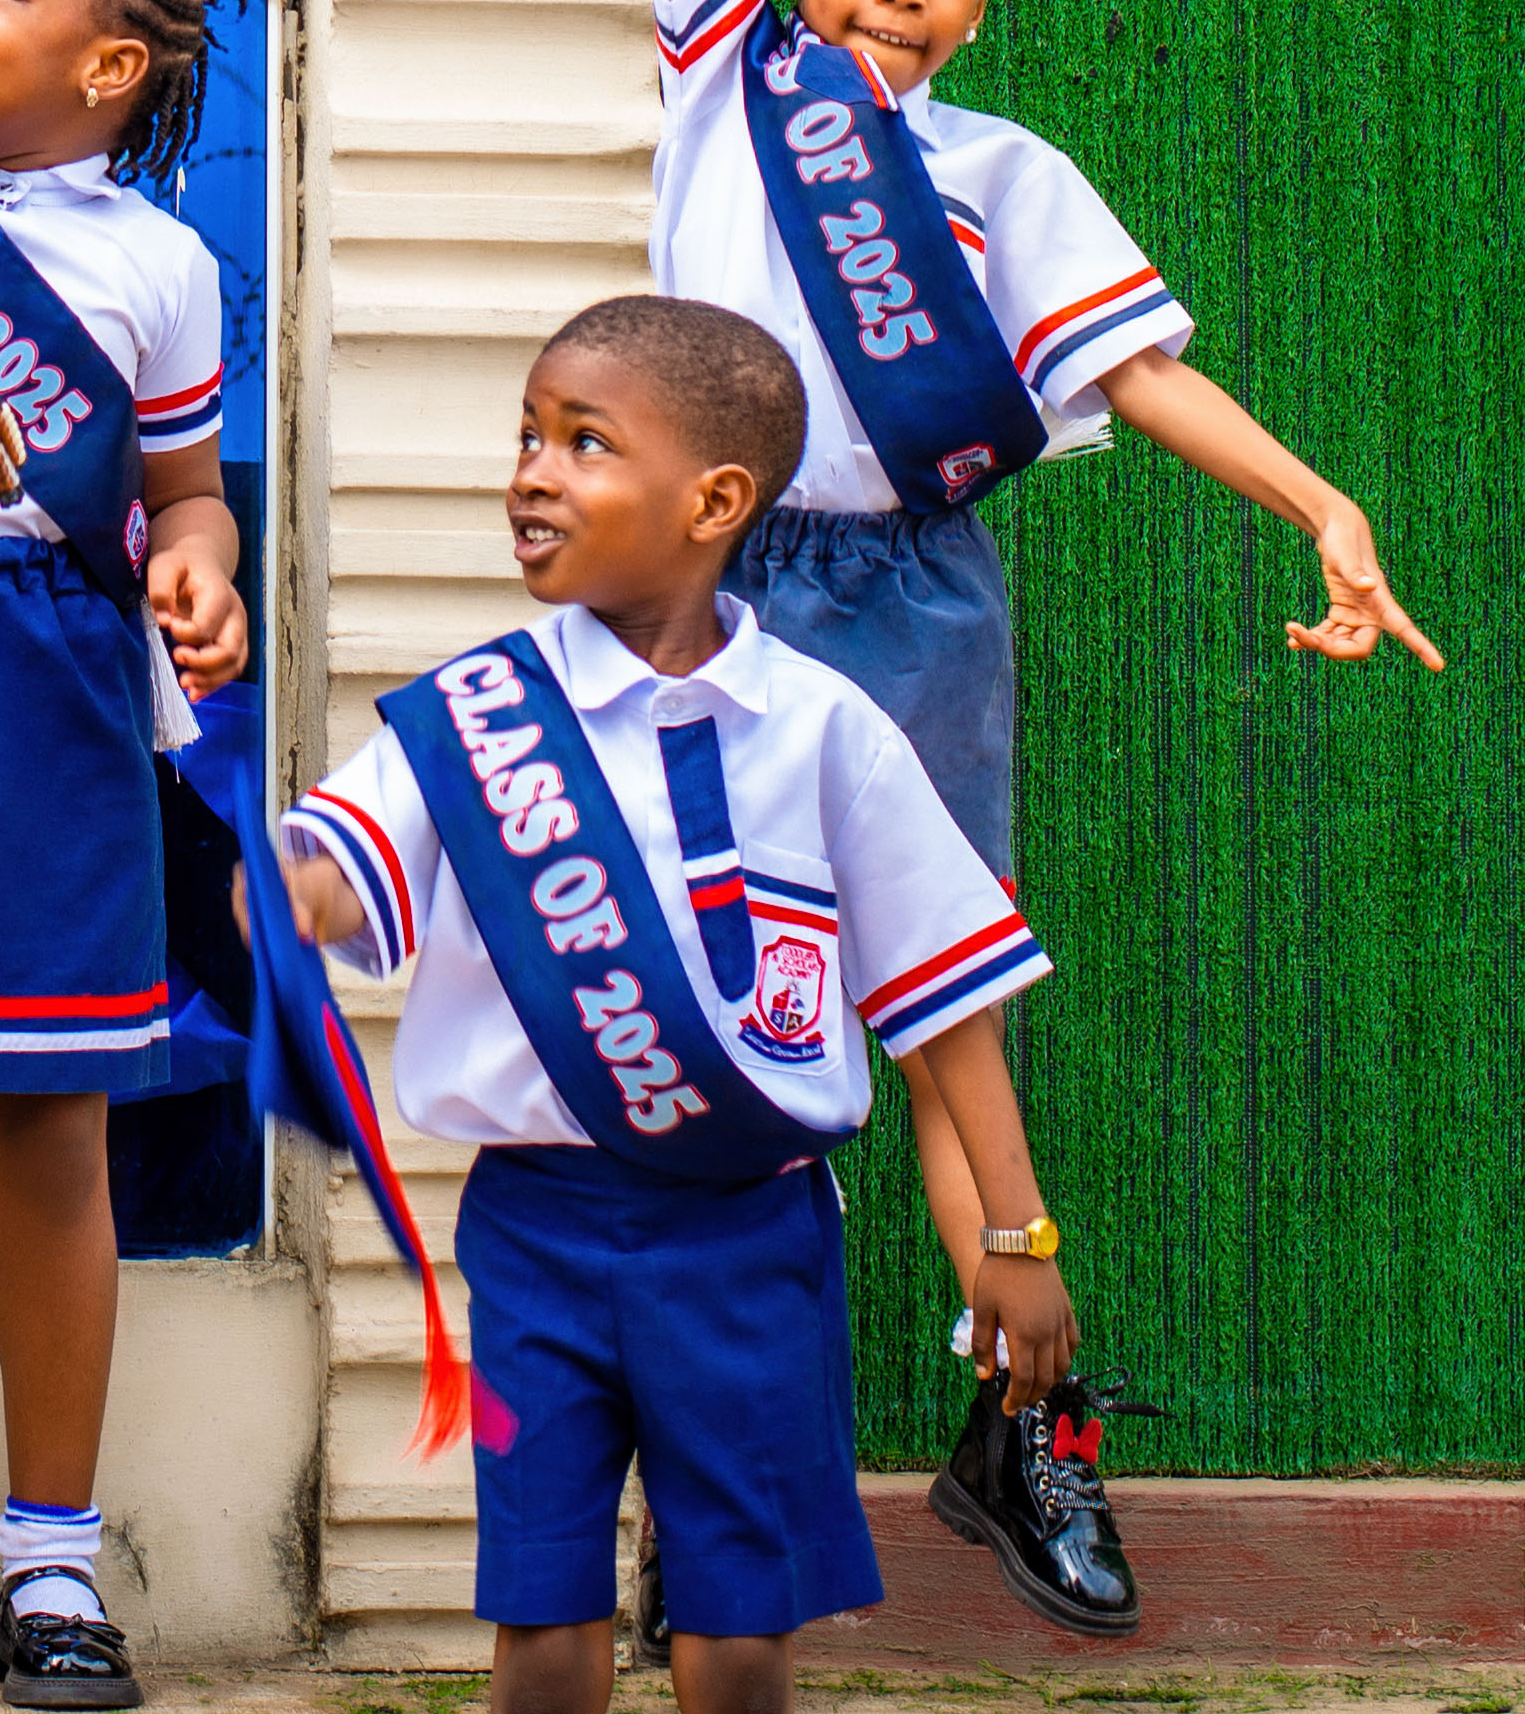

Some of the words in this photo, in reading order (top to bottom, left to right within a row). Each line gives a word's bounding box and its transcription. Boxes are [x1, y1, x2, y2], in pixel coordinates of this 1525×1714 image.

[785, 101, 873, 185] OF
[819, 200, 938, 361] 2025
[435, 652, 579, 857] CLASS
[530, 855, 628, 955] OF
[572, 968, 710, 1135] 2025
